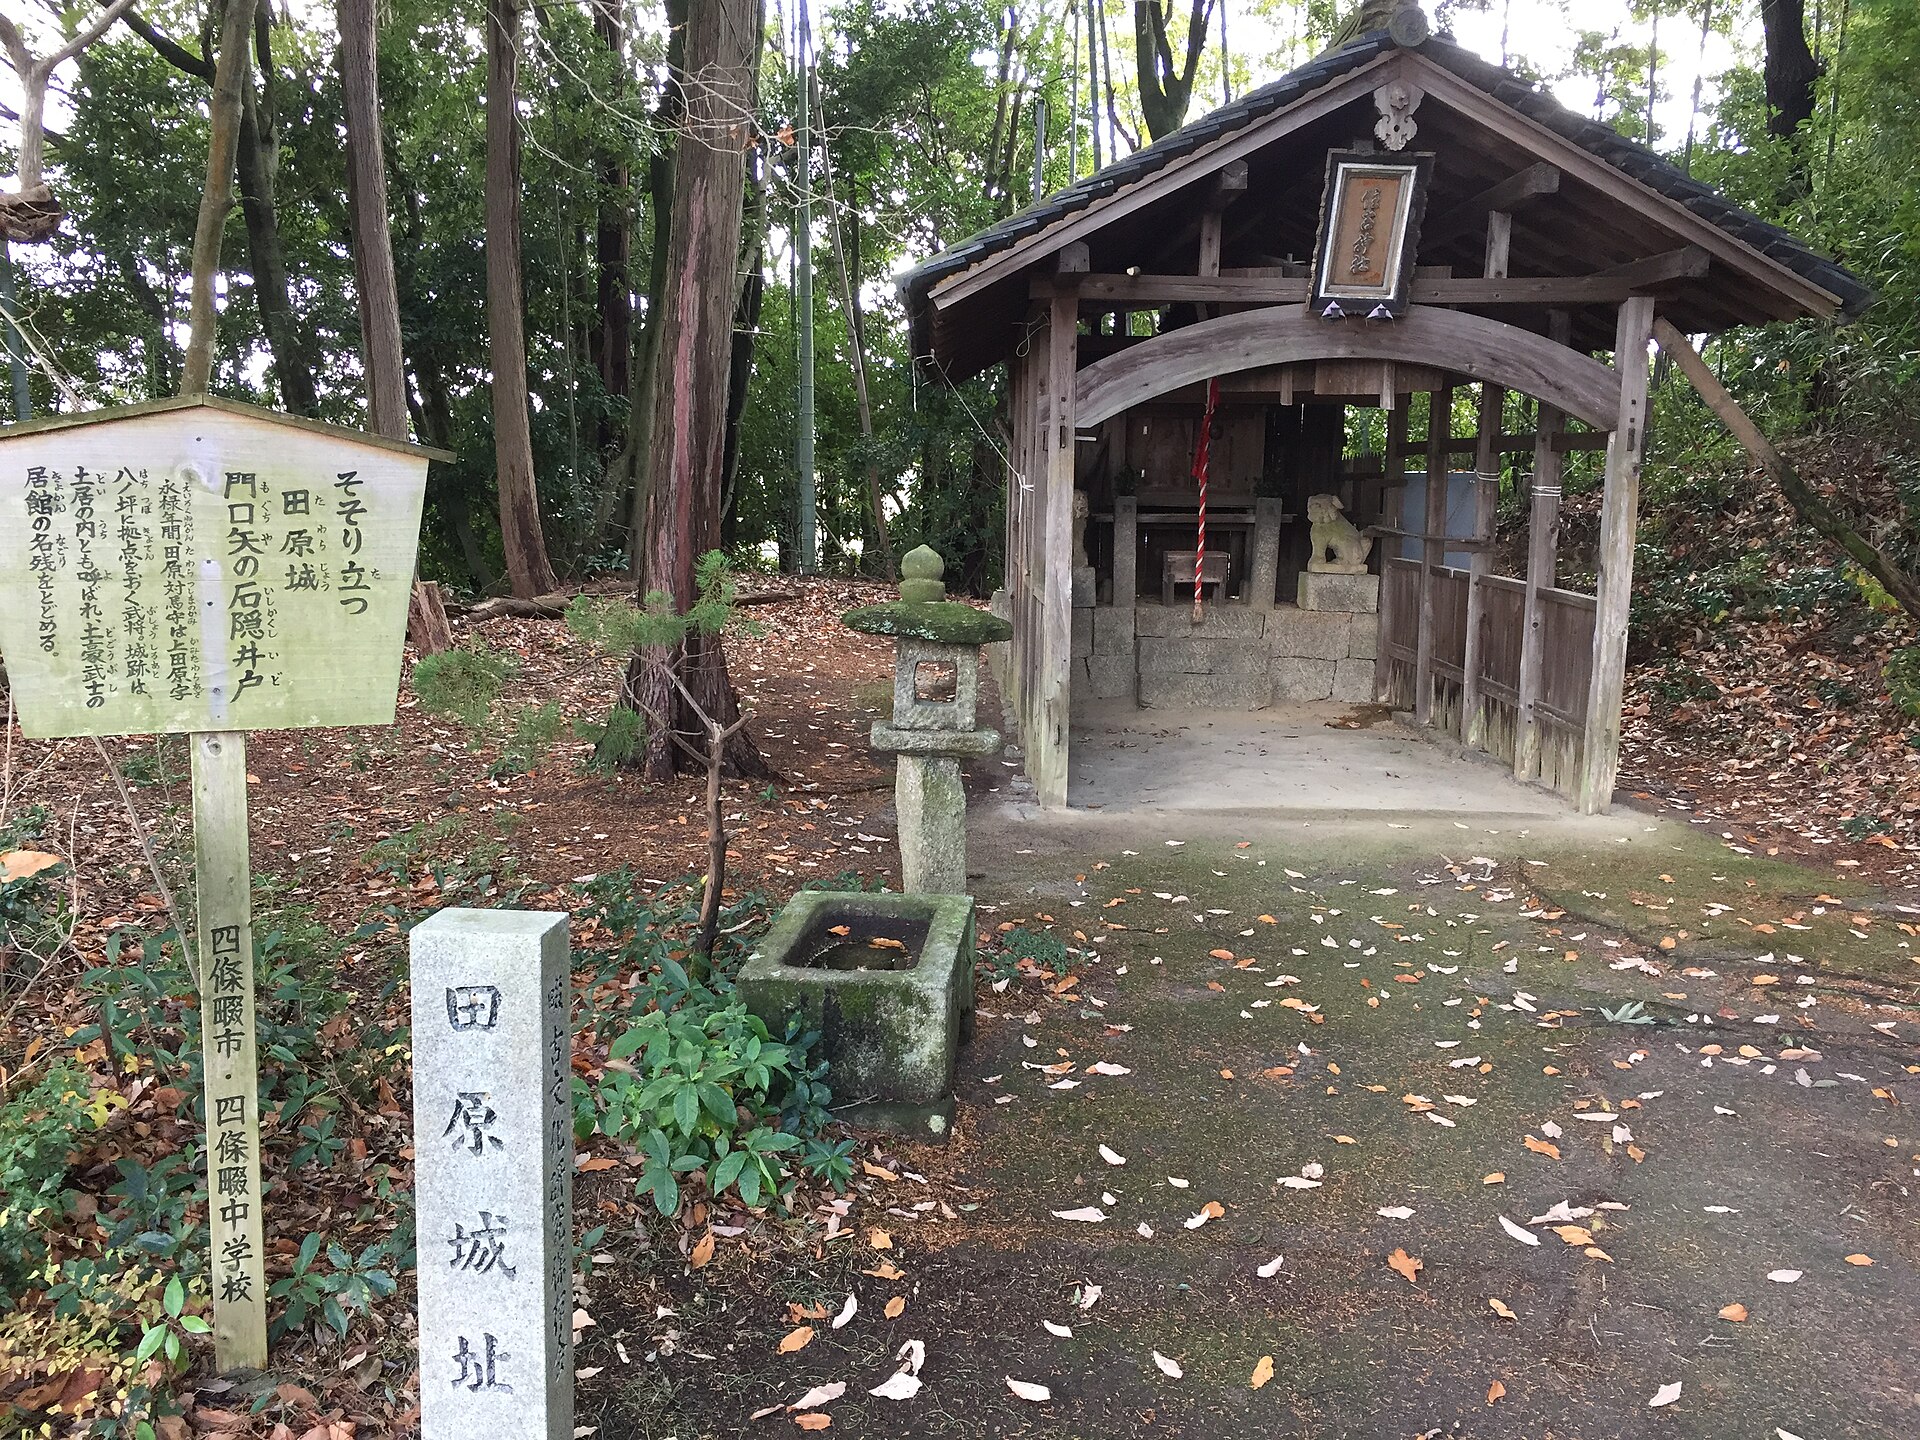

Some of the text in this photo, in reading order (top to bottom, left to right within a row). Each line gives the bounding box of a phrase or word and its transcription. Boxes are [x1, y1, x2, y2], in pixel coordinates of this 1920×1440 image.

[24, 466, 59, 657] 居館の名残をとどめる。
[223, 471, 265, 703] 門口矢の石隠井戸
[279, 489, 319, 592] 田原城
[333, 470, 371, 615] そそり立つ
[370, 567, 381, 580] た
[442, 984, 517, 1394] 田原城址
